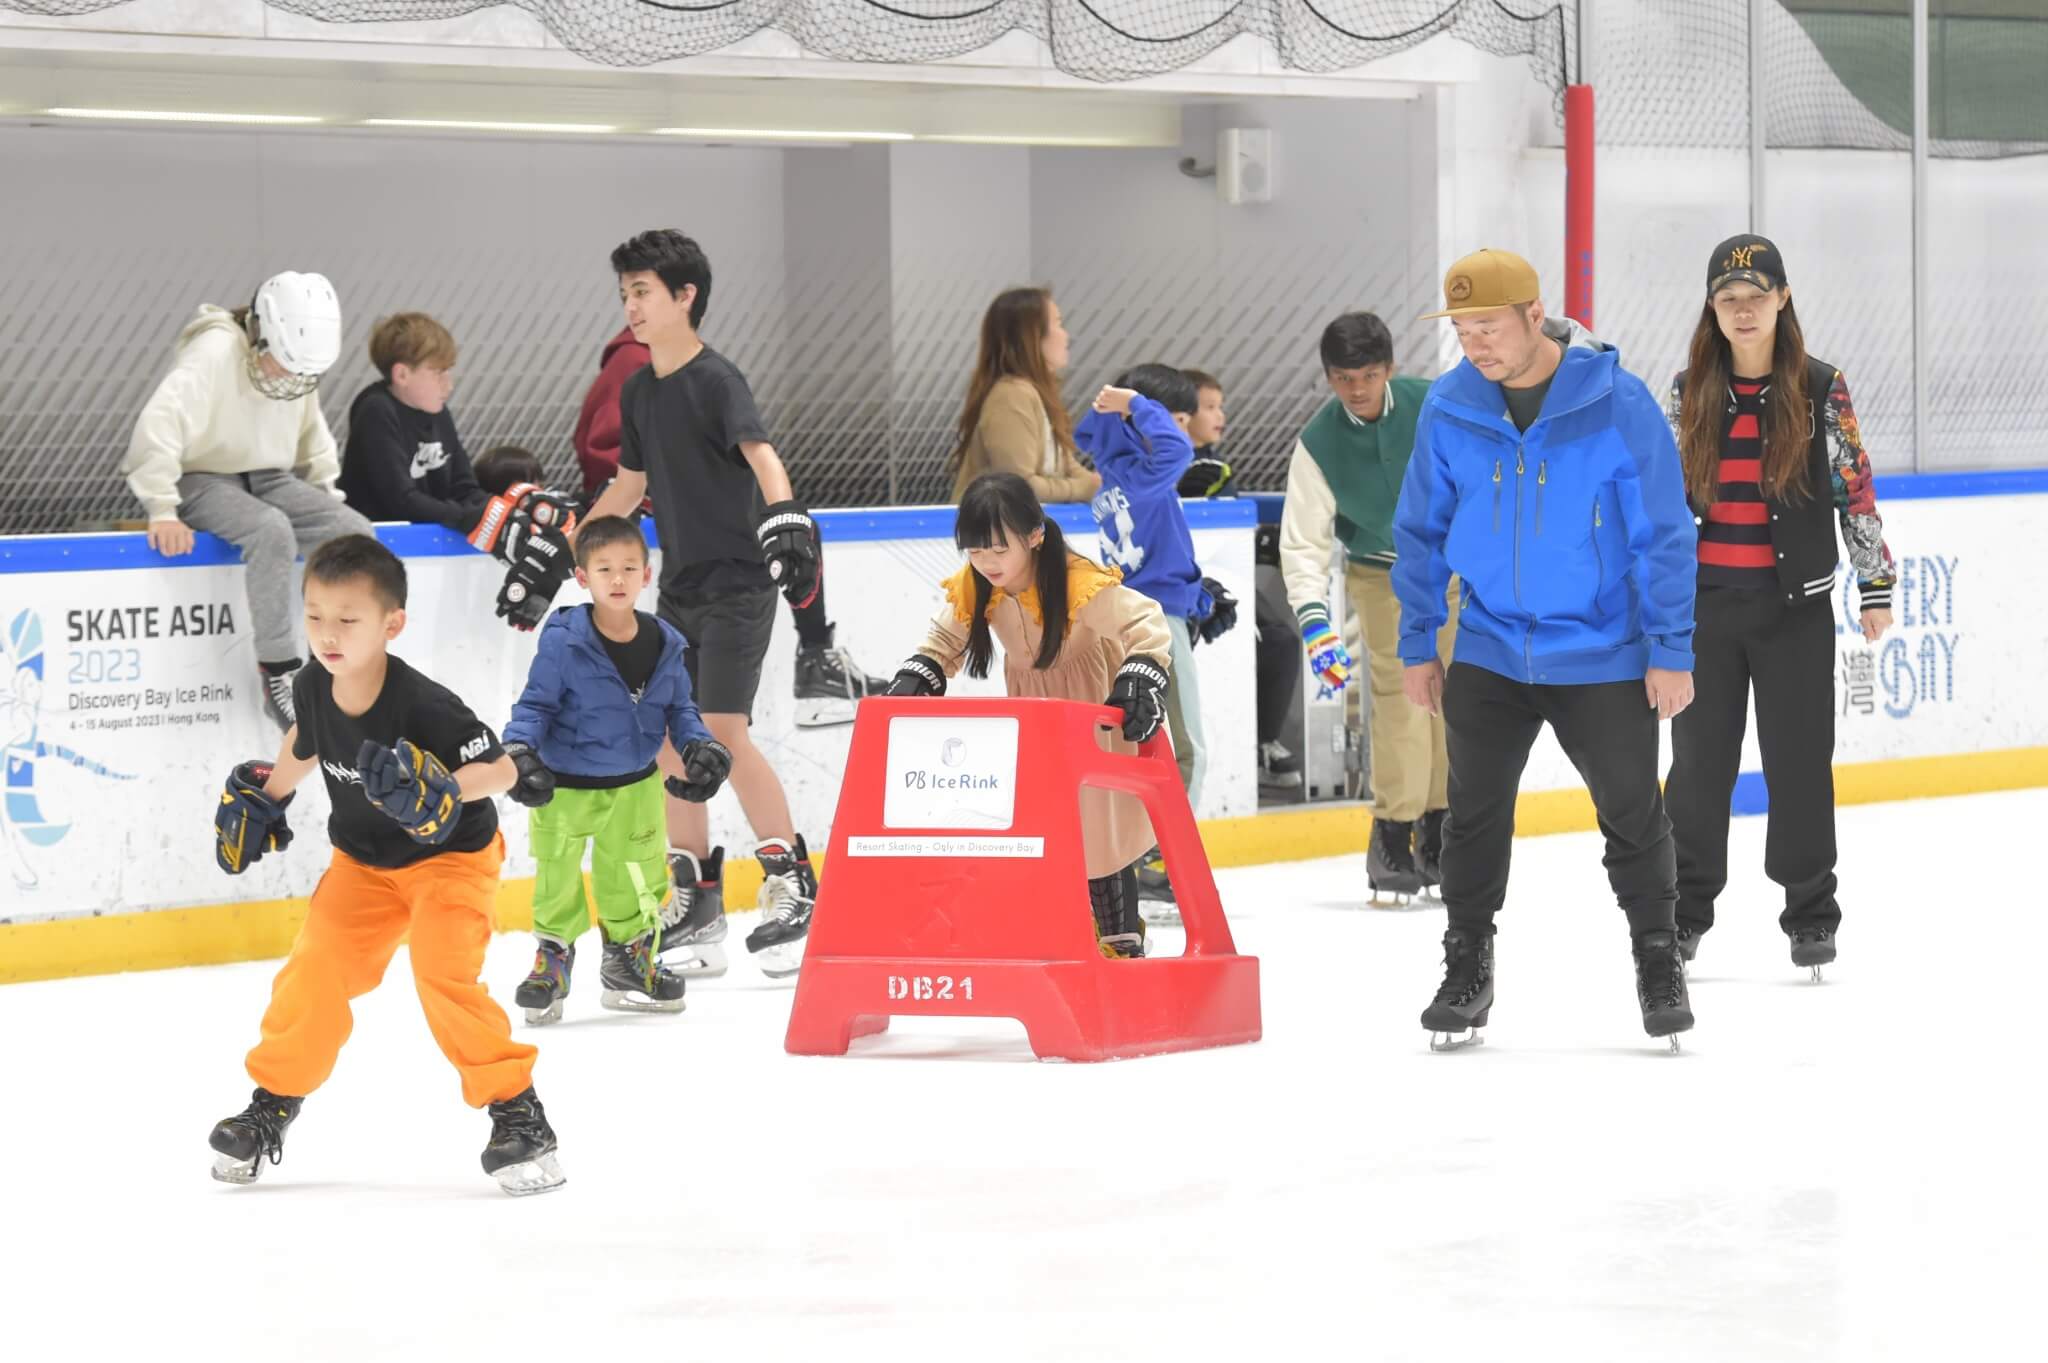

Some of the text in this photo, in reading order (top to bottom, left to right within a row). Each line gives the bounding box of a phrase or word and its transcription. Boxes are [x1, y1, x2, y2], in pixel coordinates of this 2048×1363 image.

[67, 603, 236, 642] SKATE ASIA
[67, 648, 142, 684] 2023
[1880, 632, 1959, 719] BAY
[68, 683, 233, 711] Discovery Bay Ice Rink
[69, 720, 77, 731] 4
[98, 717, 133, 732] August
[135, 714, 160, 727] 2023
[167, 712, 193, 727] Hong
[195, 711, 220, 724] Kong
[905, 770, 926, 789] DB
[856, 842, 886, 852] Resort
[888, 841, 923, 854] Skating
[968, 842, 1014, 854] Discovery
[1017, 842, 1035, 854] Bay
[888, 976, 974, 1001] DB21
